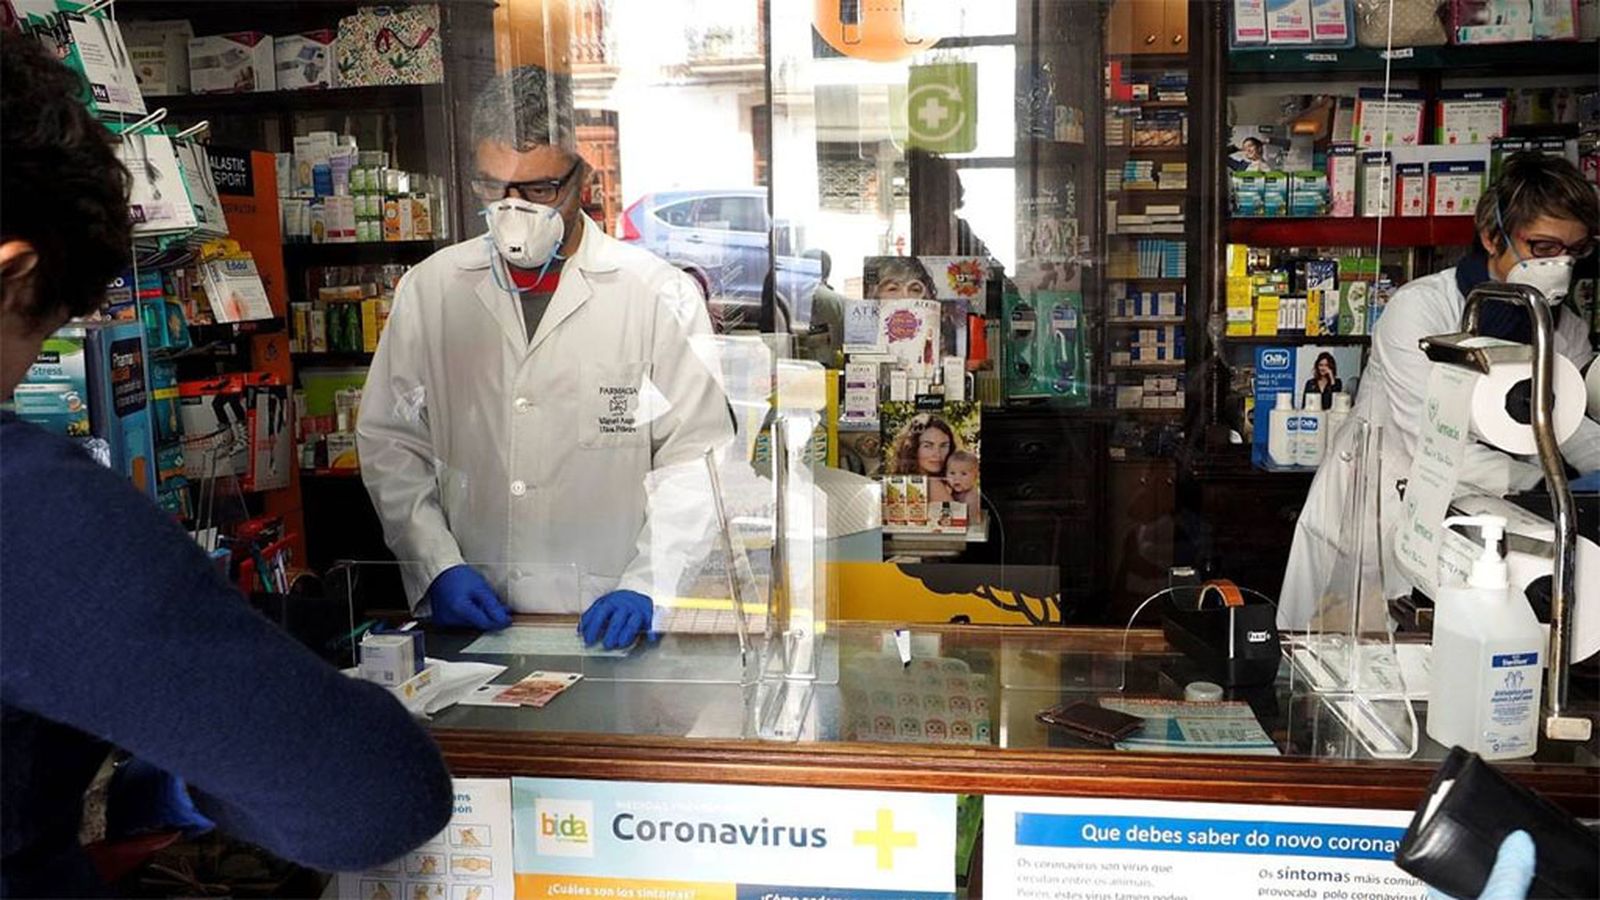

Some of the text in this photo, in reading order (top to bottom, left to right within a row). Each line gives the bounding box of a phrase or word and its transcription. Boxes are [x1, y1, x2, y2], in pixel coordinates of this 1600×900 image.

[32, 366, 63, 376] Stress
[612, 813, 828, 848] Coronavirus
[1081, 823, 1121, 842] Que
[1126, 825, 1182, 844] debes
[1187, 827, 1240, 845] saber
[1245, 829, 1269, 847] do
[1275, 834, 1323, 849] novo
[1122, 863, 1149, 873] virus
[1151, 865, 1173, 874] que
[1258, 868, 1273, 880] Os
[594, 886, 614, 897] son
[616, 885, 634, 897] los
[1258, 886, 1317, 899] provocada
[1323, 889, 1348, 900] polo
